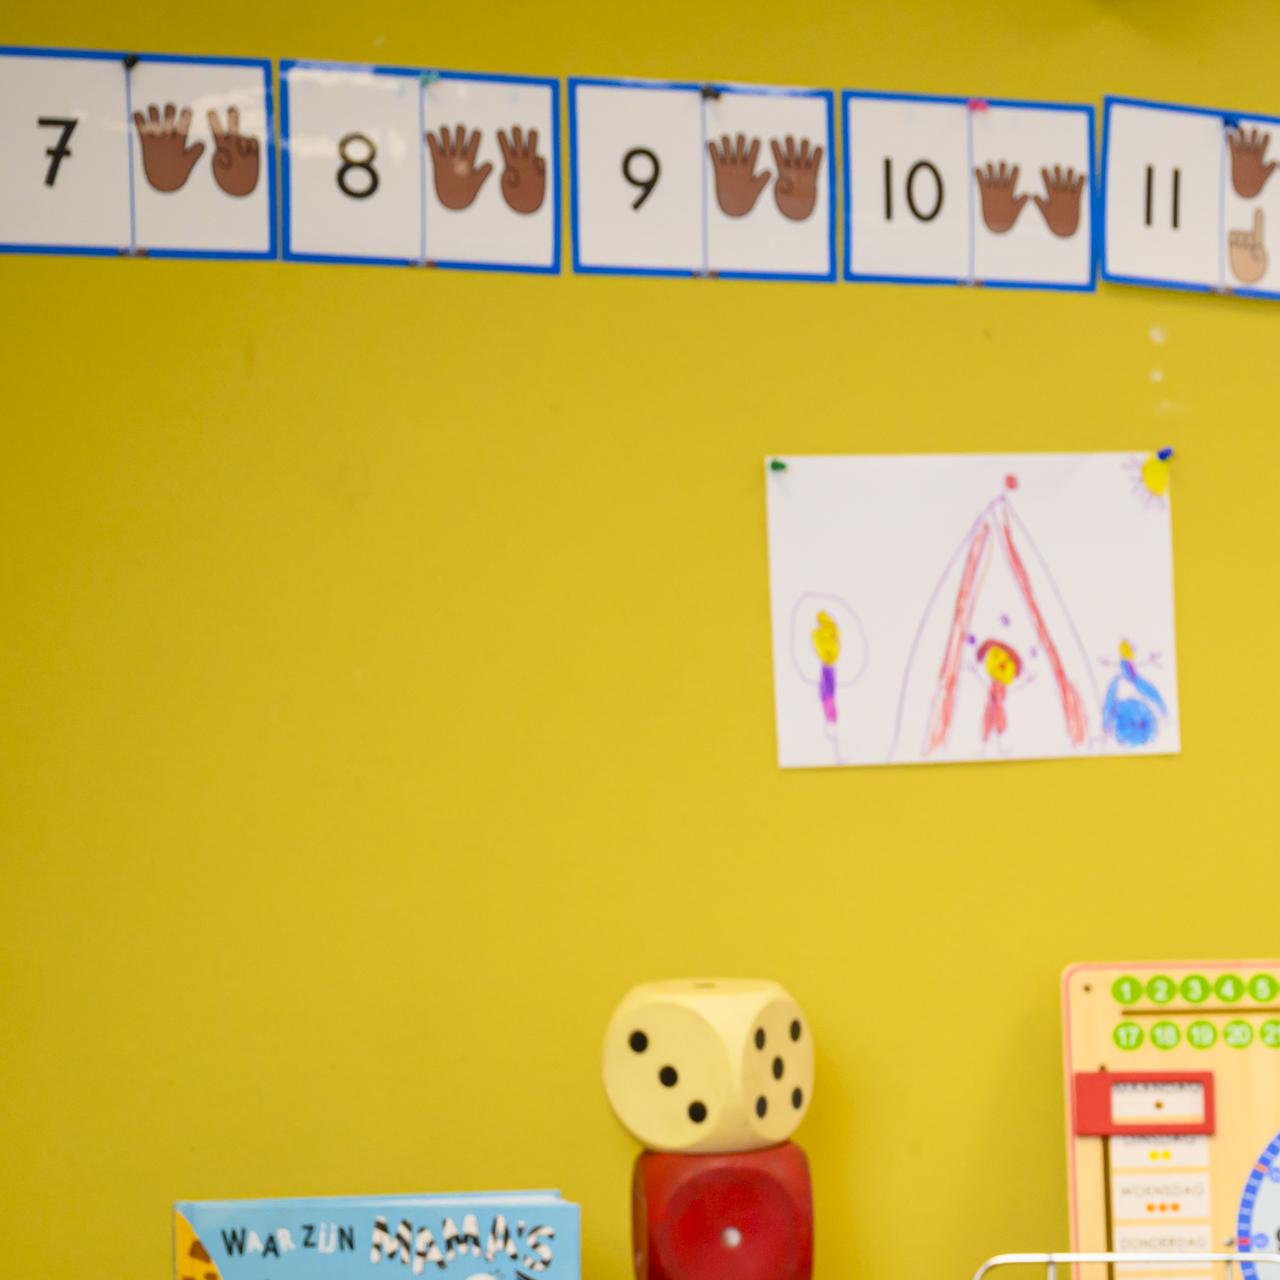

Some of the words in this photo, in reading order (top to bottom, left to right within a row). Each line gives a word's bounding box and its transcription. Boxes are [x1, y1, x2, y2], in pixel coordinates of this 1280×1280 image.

[37, 117, 79, 189] 7
[336, 133, 380, 200] 8
[622, 147, 662, 212] 9
[883, 157, 945, 223] 10
[1144, 164, 1182, 231] 11
[1119, 1028, 1140, 1043] 17
[221, 1227, 297, 1259] WAAR
[370, 1214, 556, 1275] MAMA'S
